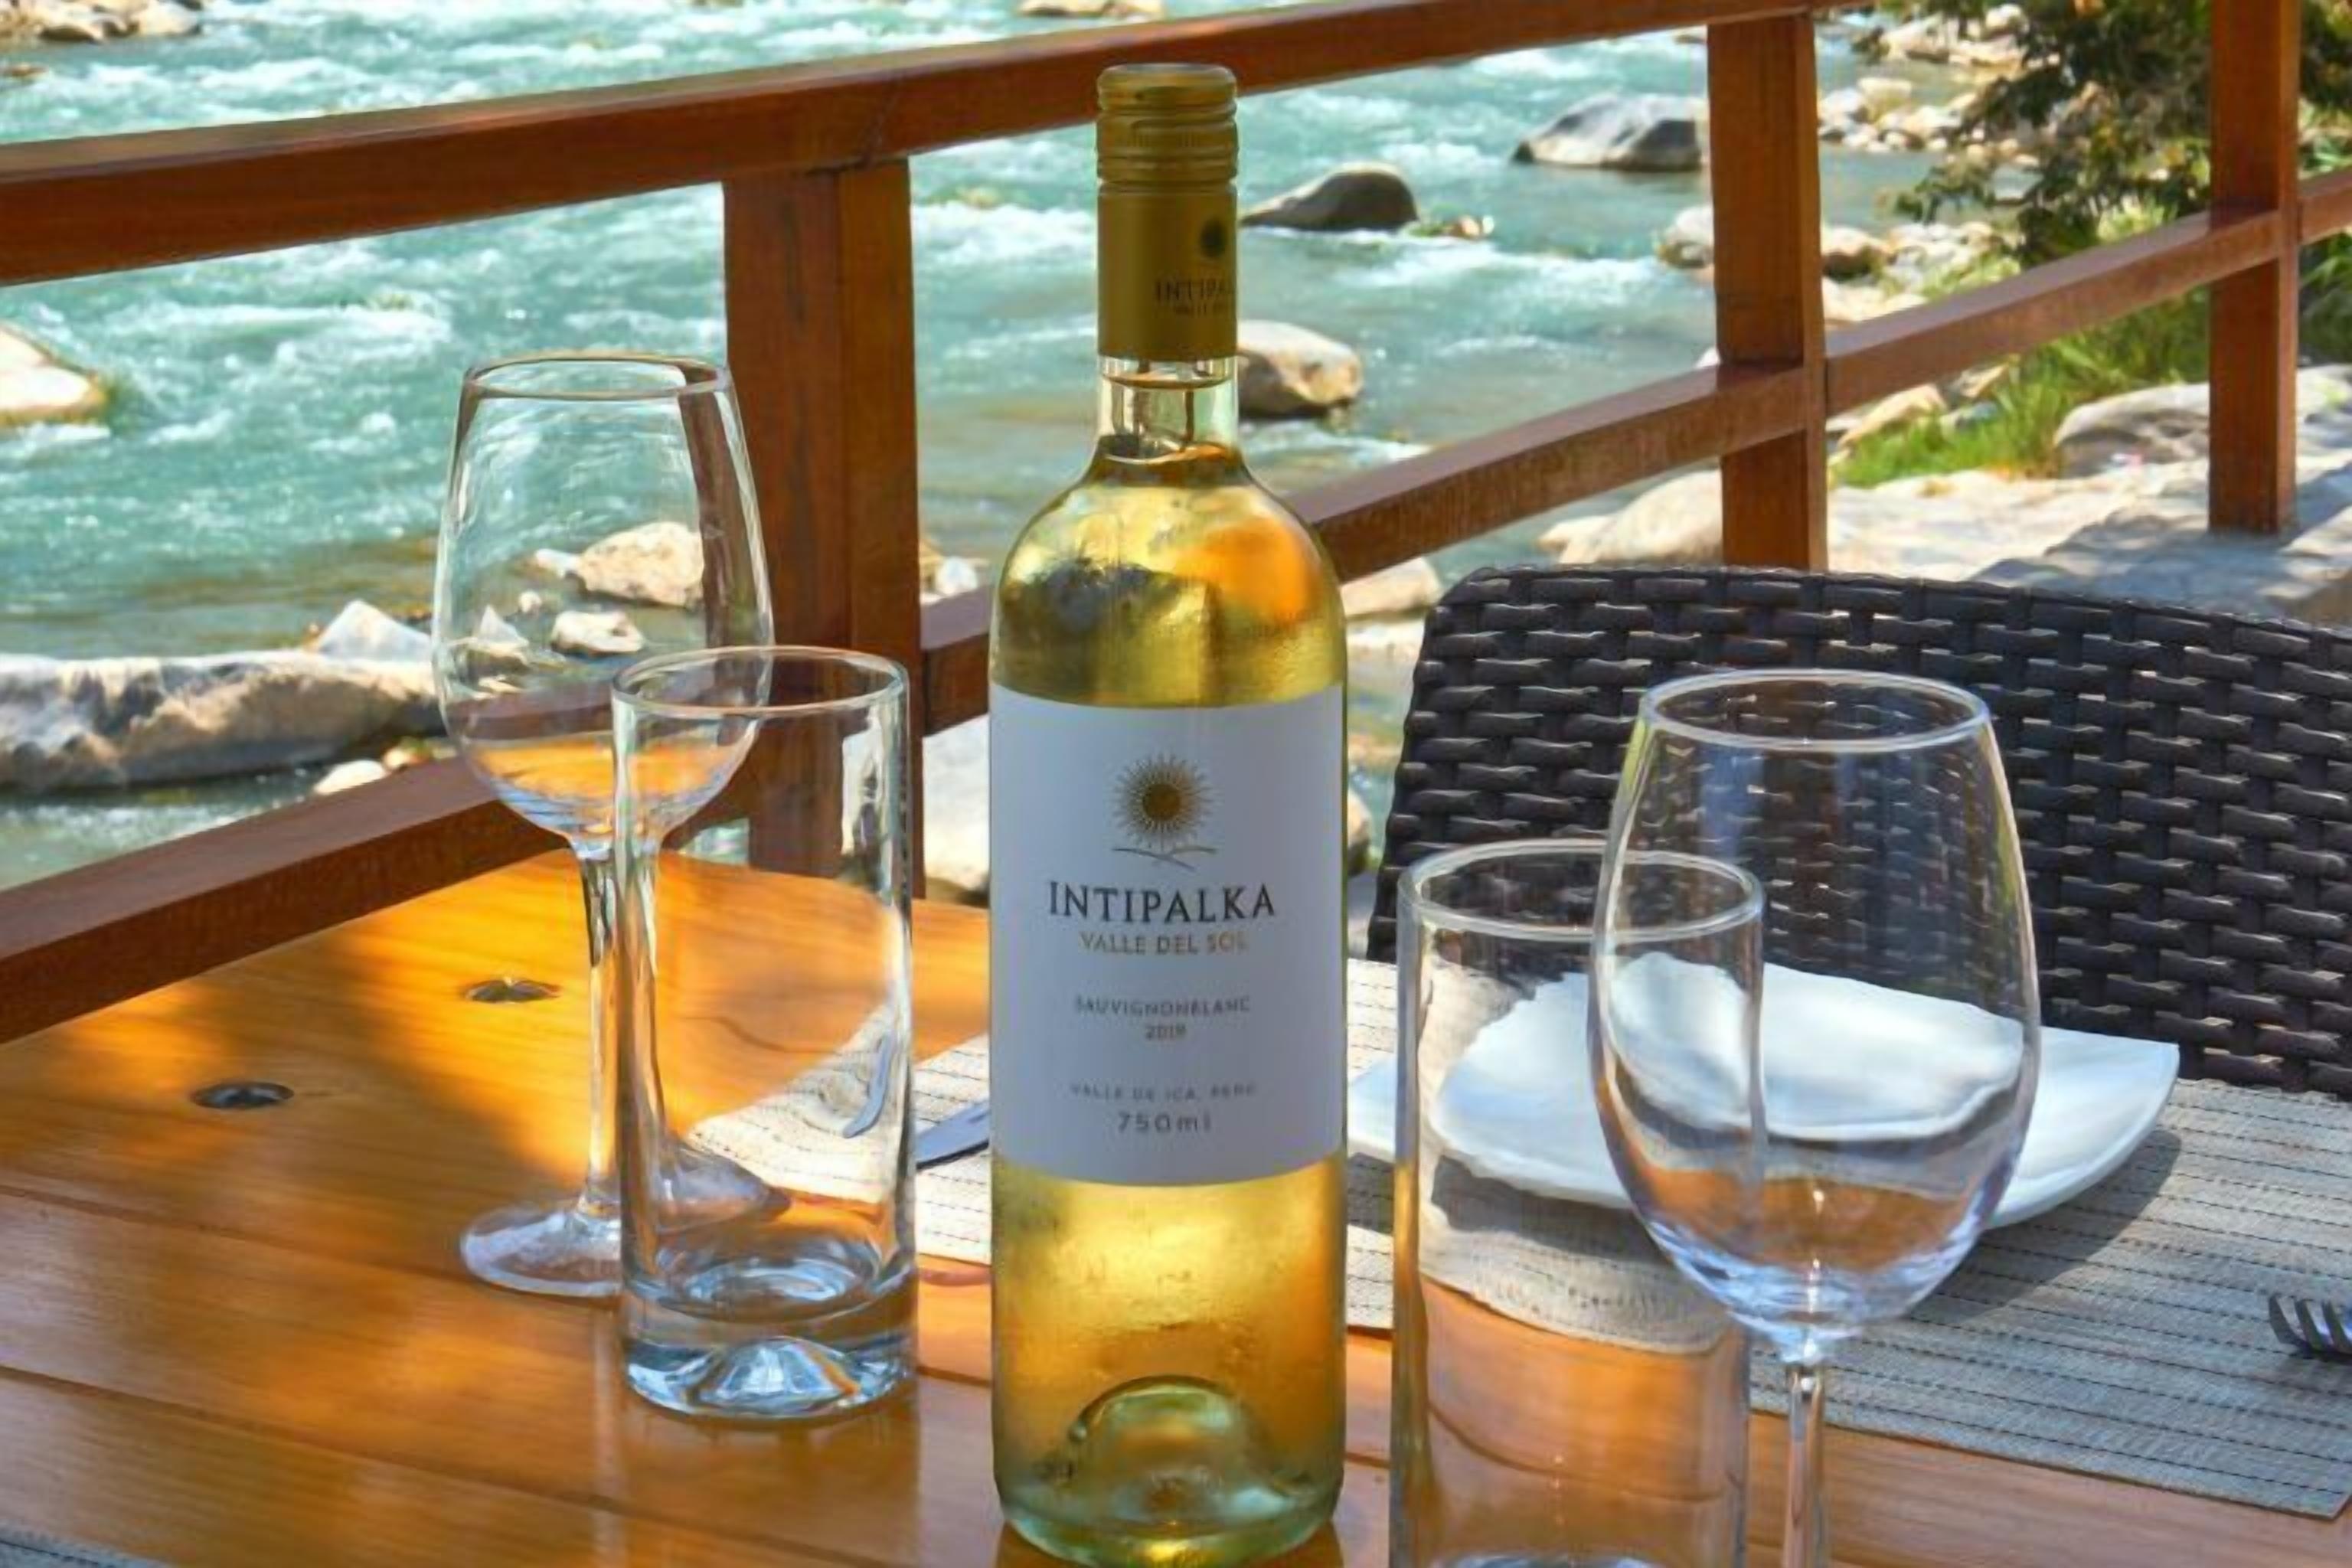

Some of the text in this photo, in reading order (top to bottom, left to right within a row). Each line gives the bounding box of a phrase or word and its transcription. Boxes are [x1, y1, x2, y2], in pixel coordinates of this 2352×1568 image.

[1050, 881, 1275, 923] INTIPALKA
[1080, 933, 1147, 955] VALLE
[1157, 934, 1198, 956] DEL
